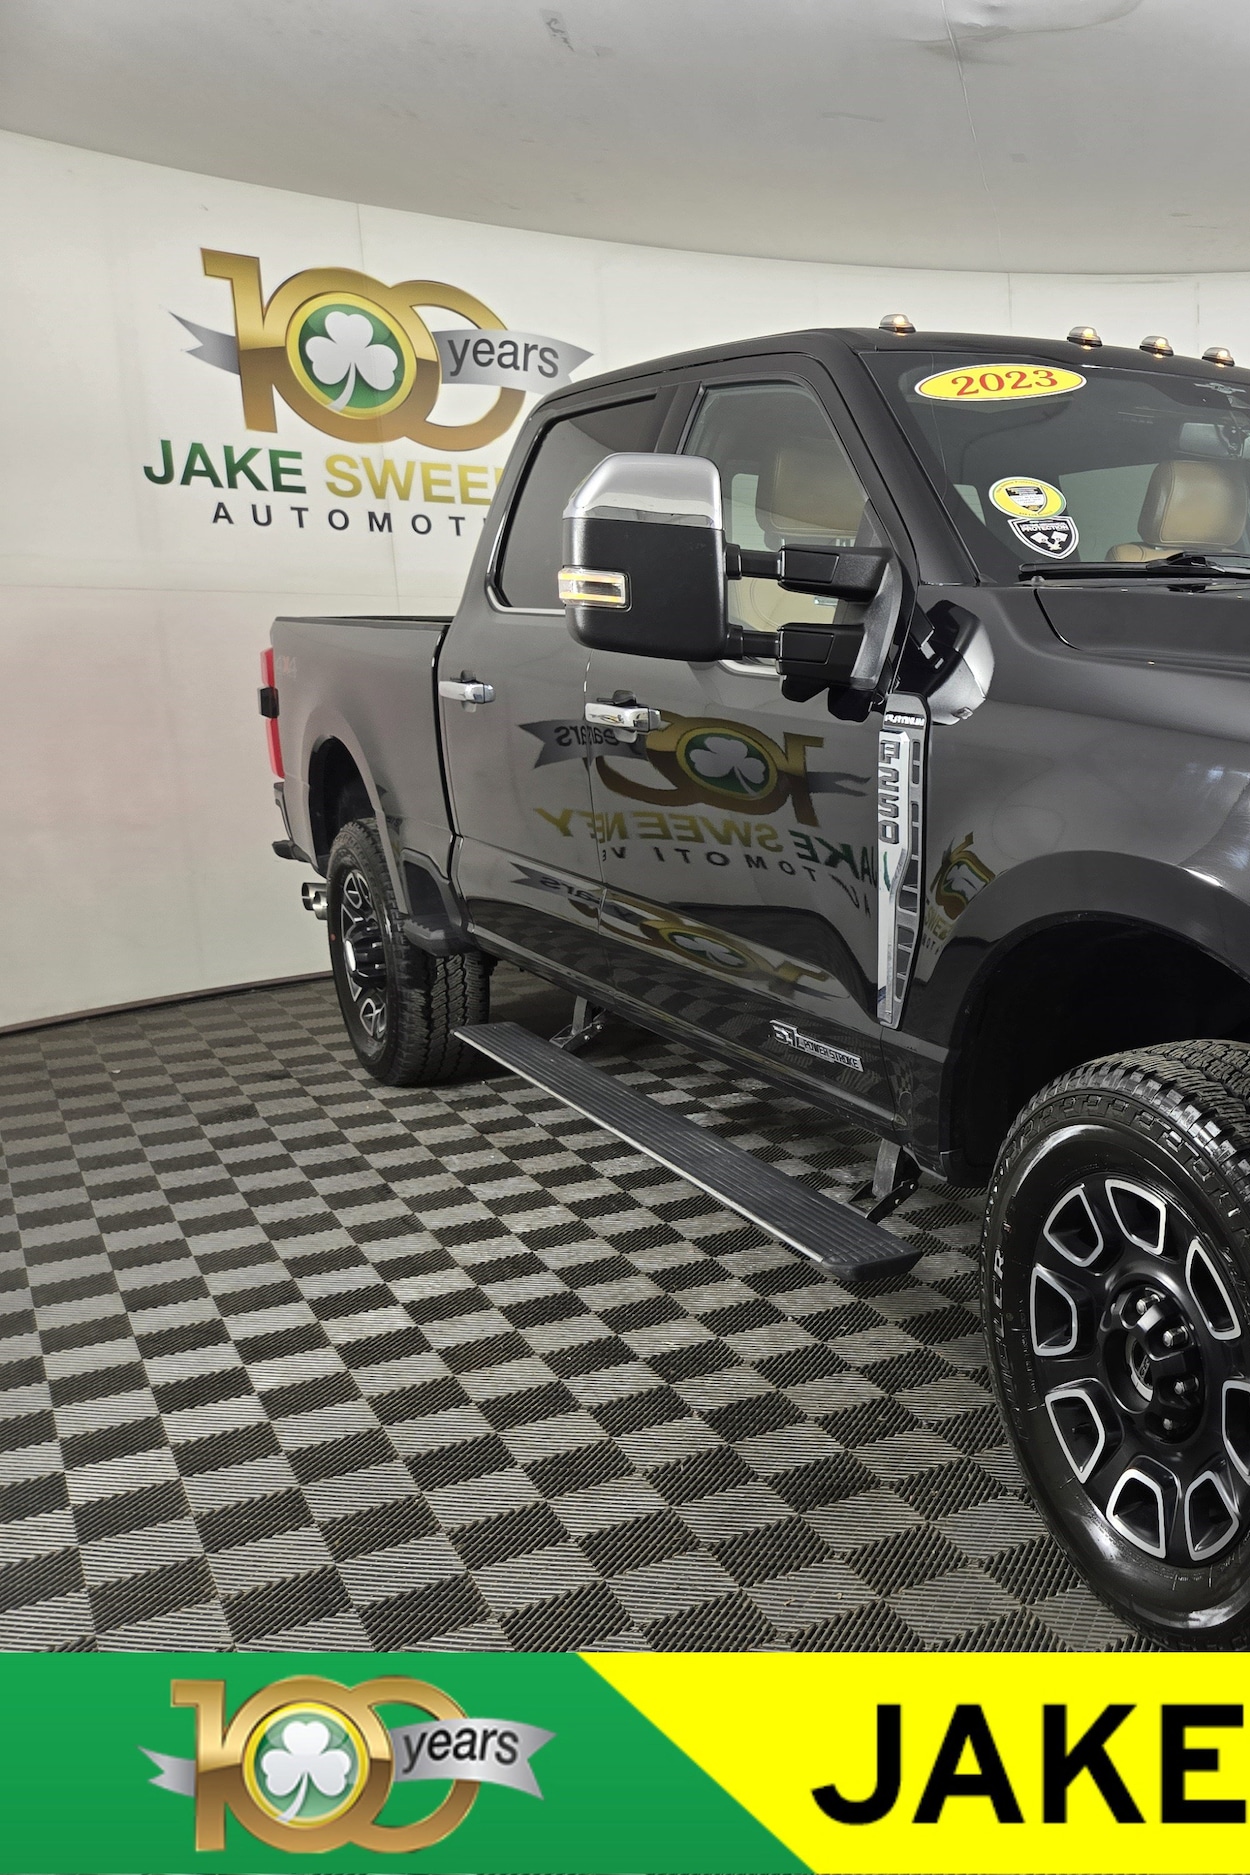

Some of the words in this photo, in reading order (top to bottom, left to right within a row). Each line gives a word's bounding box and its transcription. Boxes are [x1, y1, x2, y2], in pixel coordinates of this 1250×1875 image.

[200, 248, 527, 452] 100
[447, 337, 560, 379] years
[951, 369, 1058, 396] 2023
[143, 439, 307, 495] JAKE
[325, 454, 505, 506] SWEE
[212, 502, 487, 537] AUTOMOT
